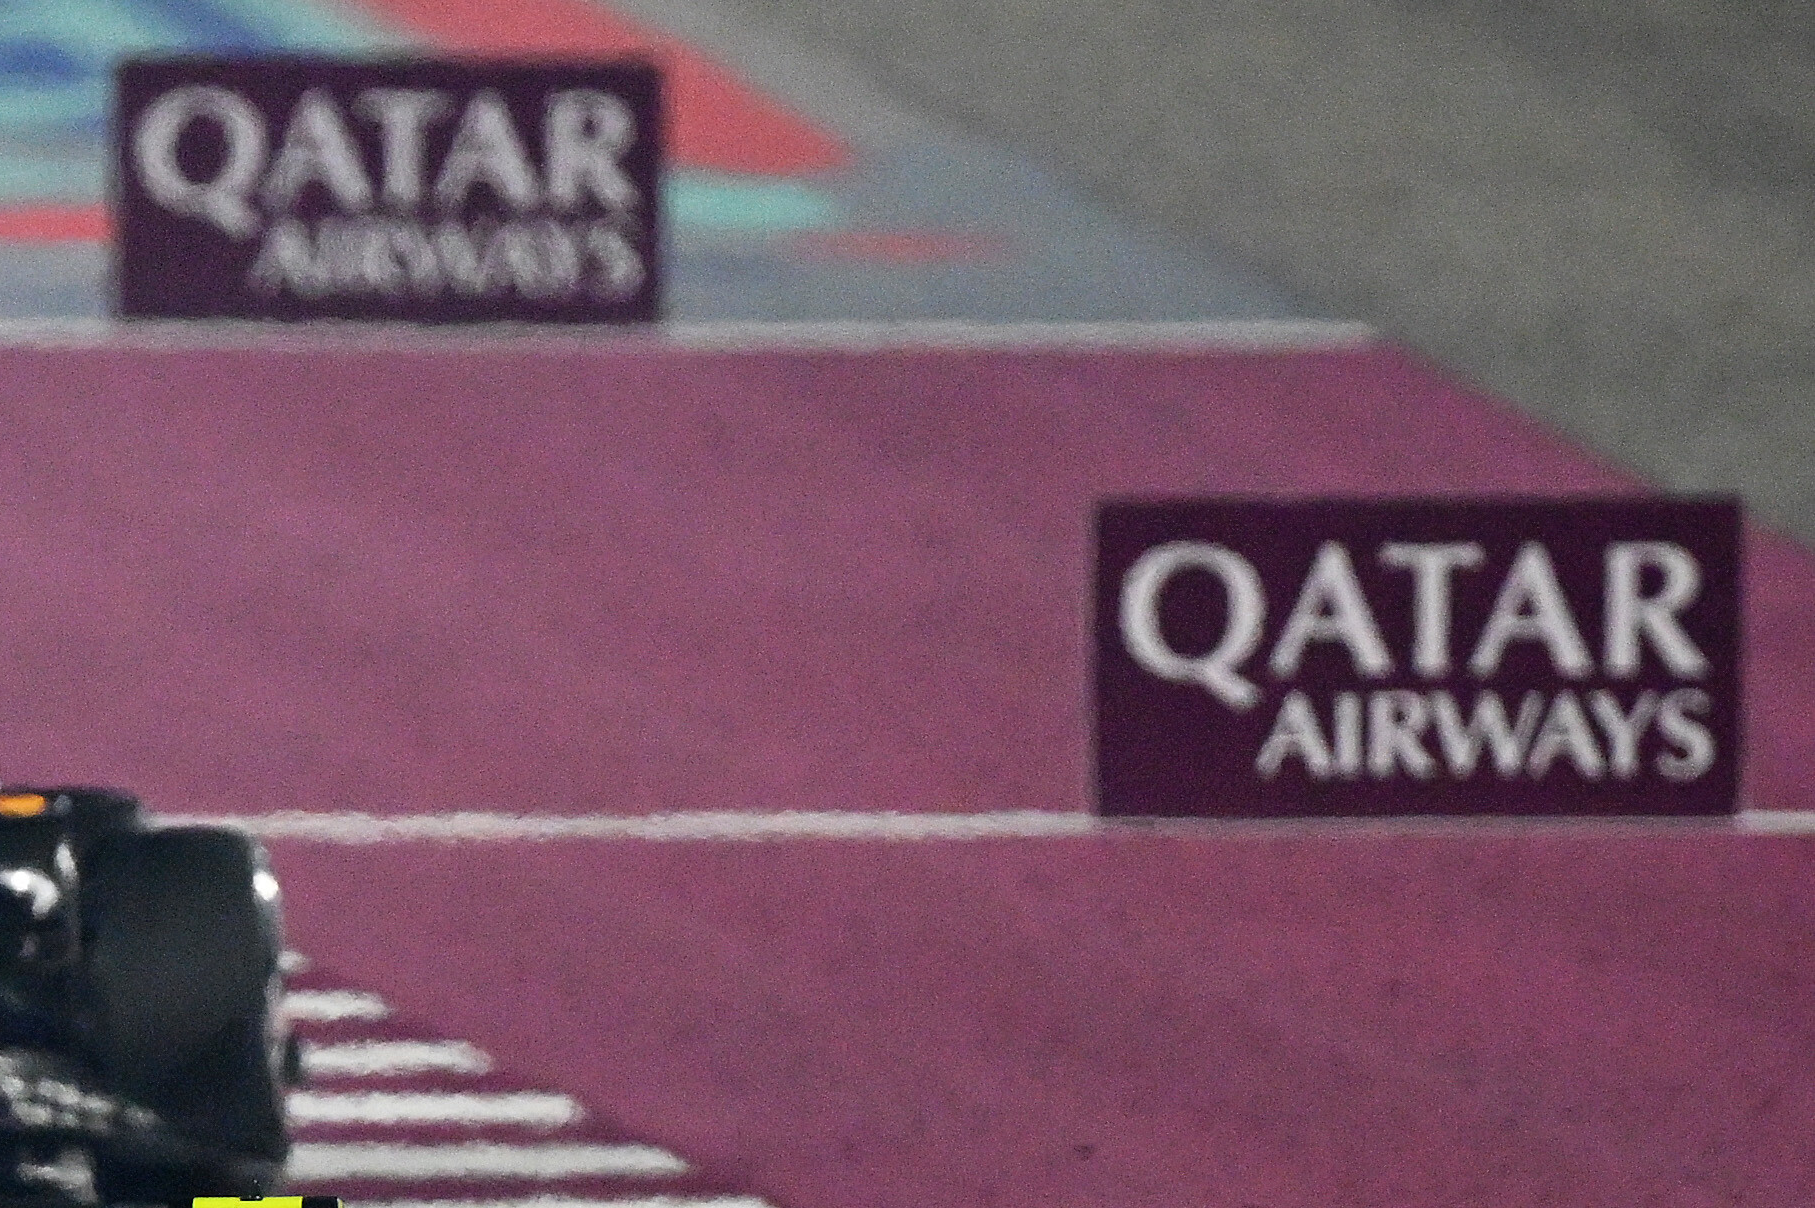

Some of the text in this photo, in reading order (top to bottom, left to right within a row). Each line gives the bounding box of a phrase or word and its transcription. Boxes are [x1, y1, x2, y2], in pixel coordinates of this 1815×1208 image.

[134, 84, 638, 238] QATAR
[1118, 540, 1710, 710] QATAR
[1254, 689, 1716, 778] AIRWAYS
